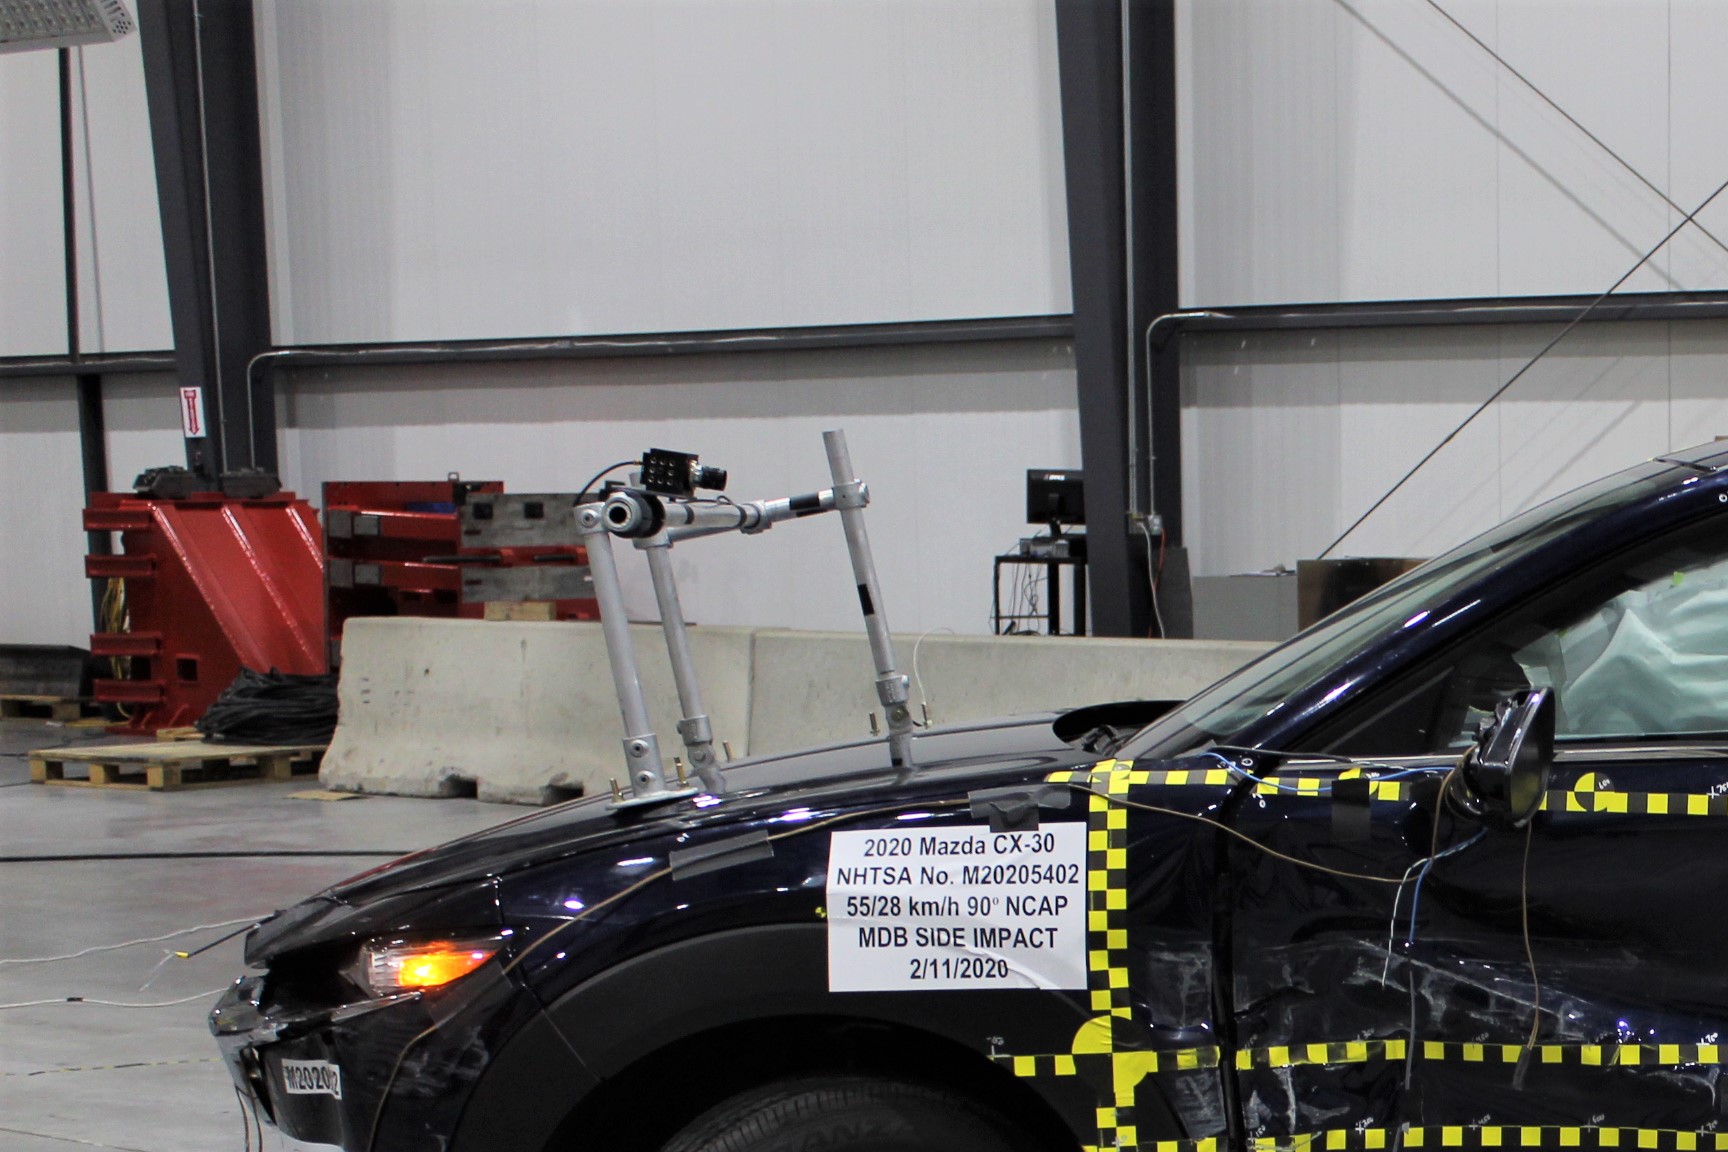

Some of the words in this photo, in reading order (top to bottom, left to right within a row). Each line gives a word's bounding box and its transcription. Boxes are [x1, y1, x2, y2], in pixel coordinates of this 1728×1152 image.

[863, 838, 912, 857] 2020
[919, 836, 985, 856] Mazda
[993, 832, 1055, 854] CX-30
[837, 867, 912, 885] NHTSA
[920, 866, 954, 885] No.
[963, 864, 1079, 885] M20205402
[847, 896, 901, 917] 55/28
[909, 896, 959, 917] km/h
[1006, 895, 1068, 916] NCAP
[858, 927, 908, 948] MDB
[916, 927, 966, 947] SIDE
[974, 927, 1058, 949] IMPACT
[910, 958, 1009, 980] 2/11/2020
